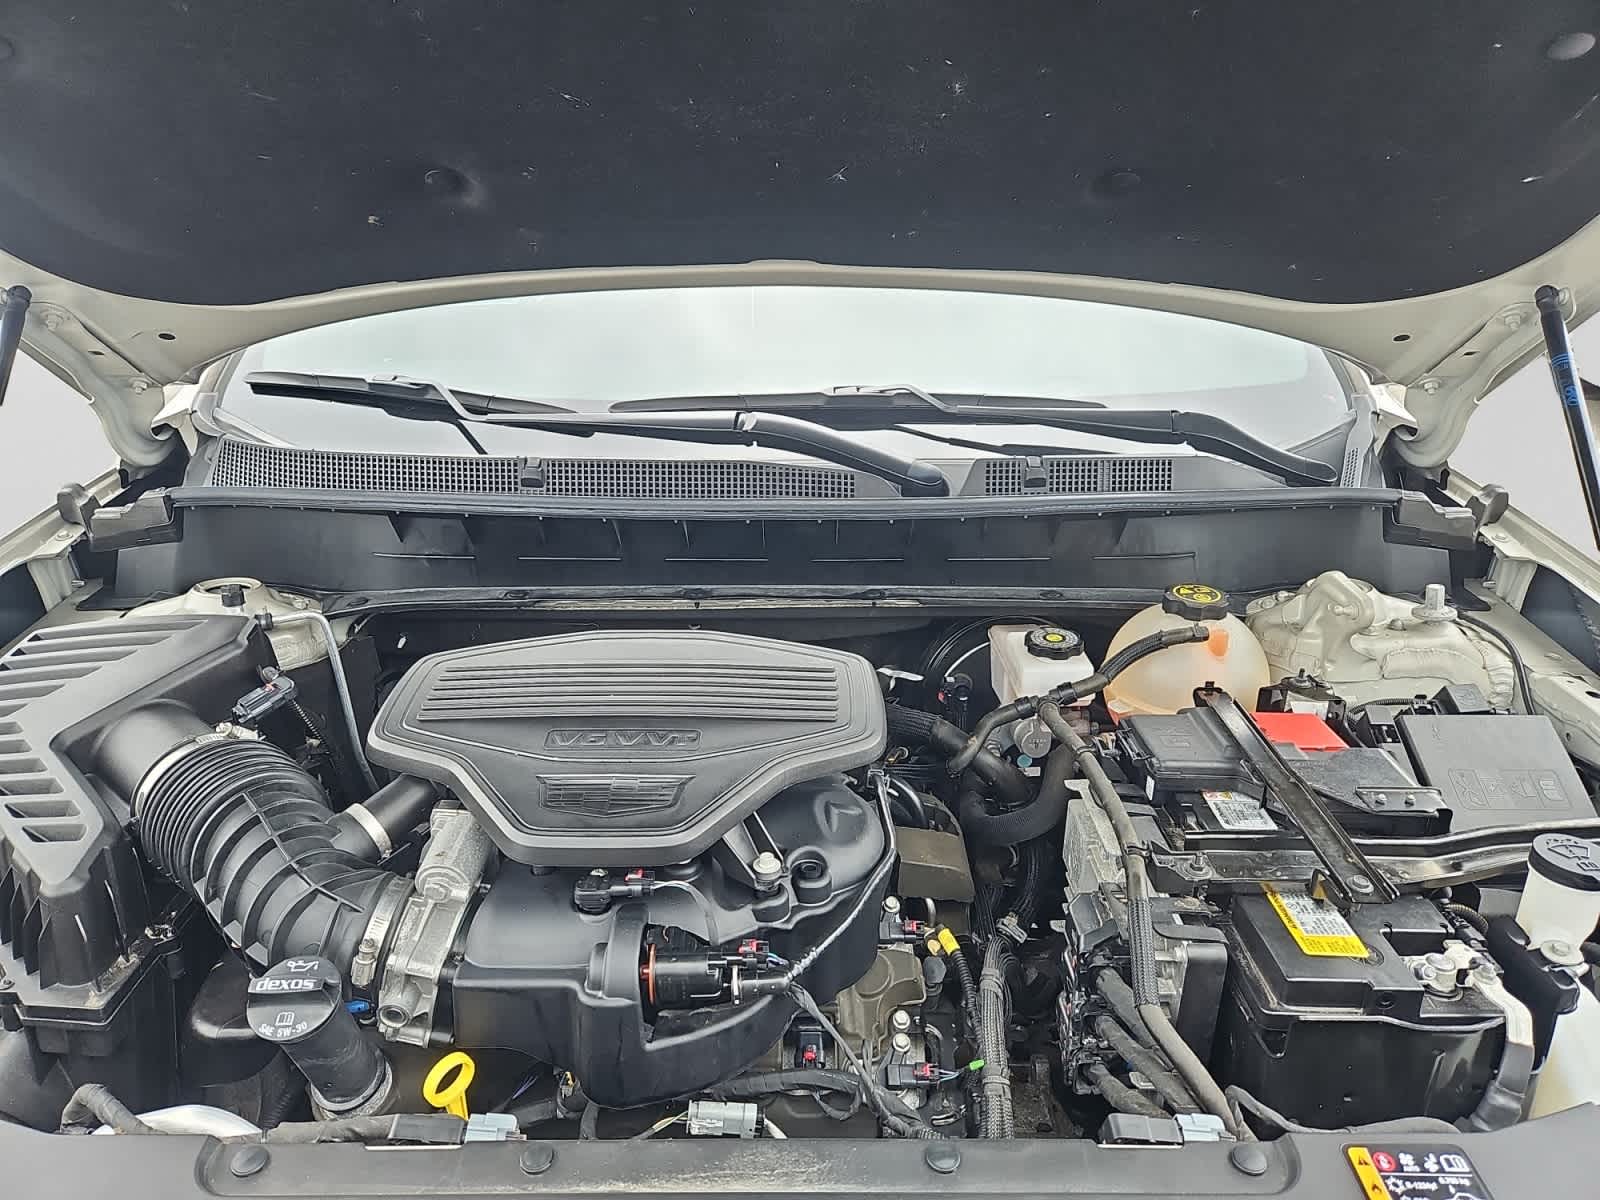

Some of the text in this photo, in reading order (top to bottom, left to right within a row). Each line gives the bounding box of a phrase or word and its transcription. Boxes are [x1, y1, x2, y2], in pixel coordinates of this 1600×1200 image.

[551, 731, 698, 746] V6 VVT
[255, 977, 317, 991] dexos
